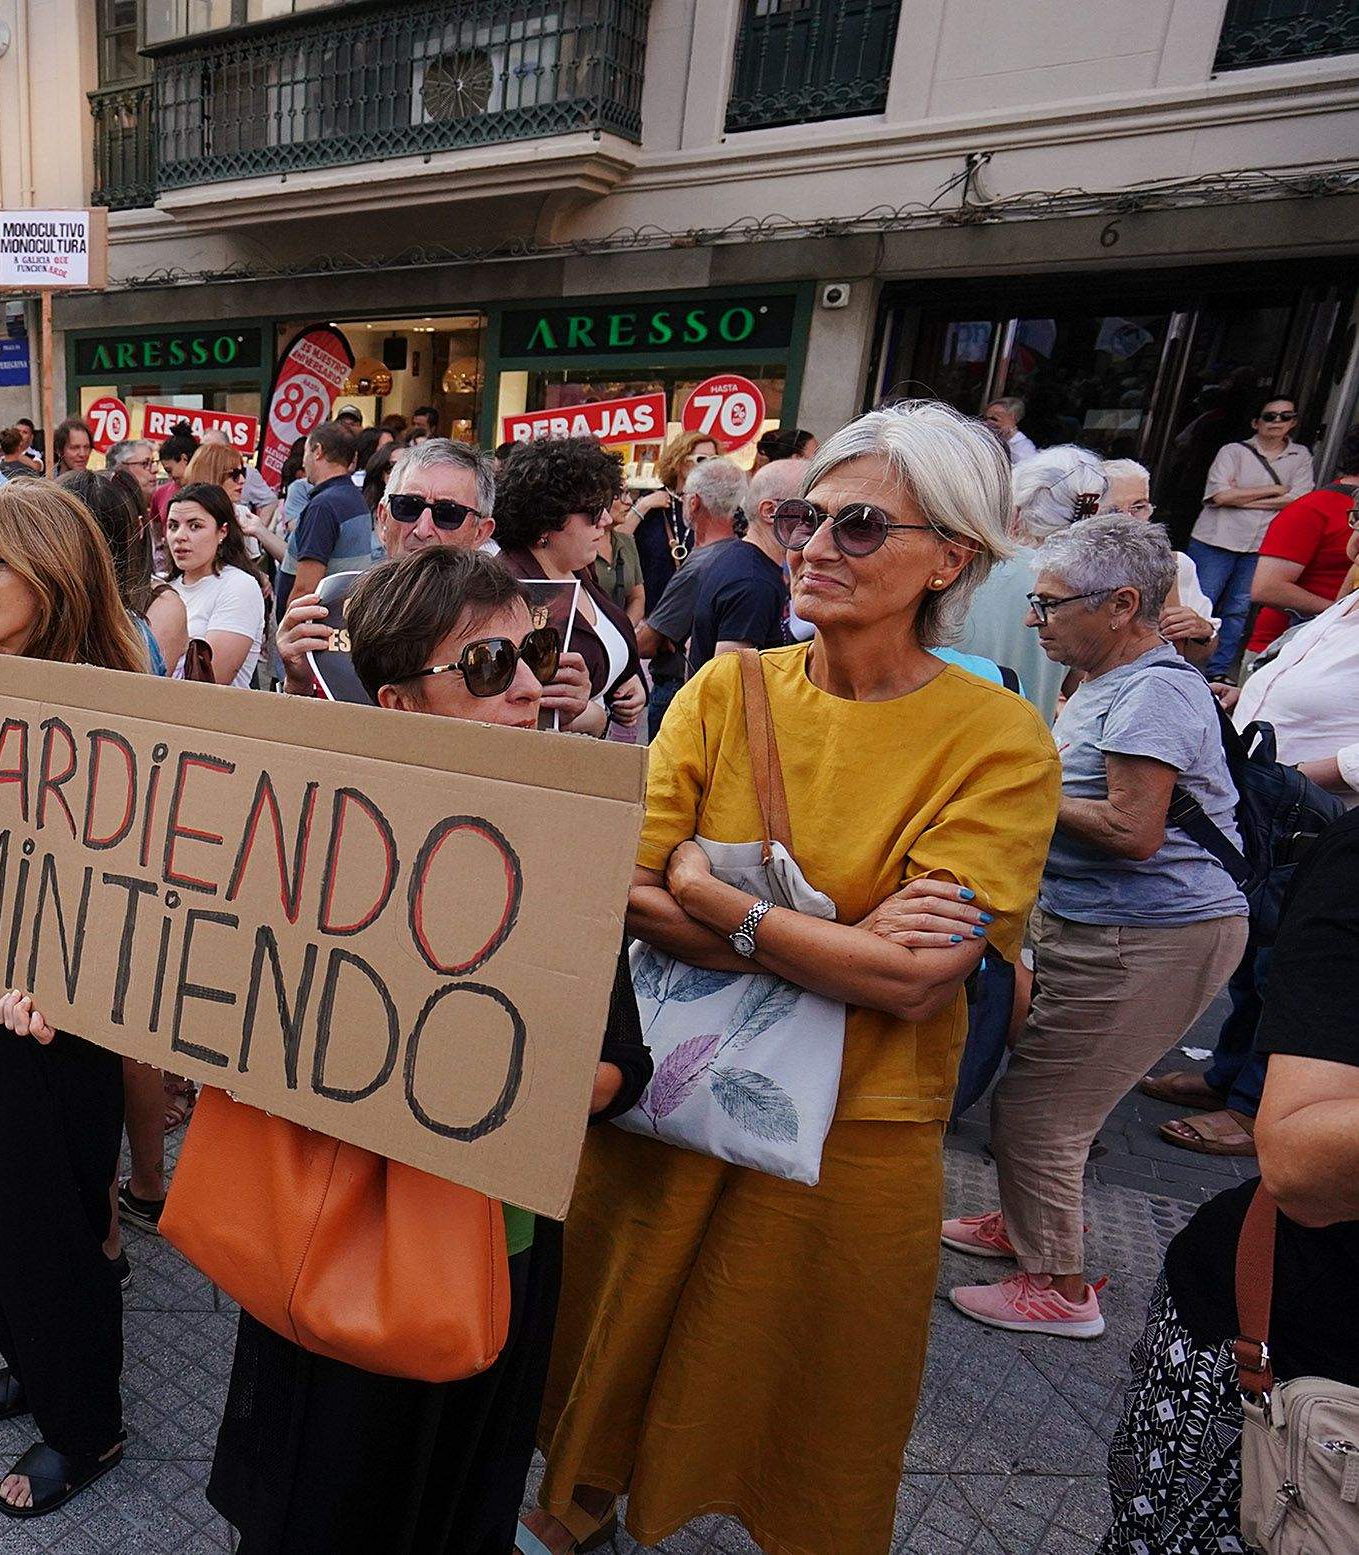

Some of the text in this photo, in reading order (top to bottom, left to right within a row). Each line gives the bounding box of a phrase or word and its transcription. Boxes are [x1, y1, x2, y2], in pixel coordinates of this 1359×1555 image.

[3, 222, 85, 237] MONOCULTIVO
[1101, 219, 1122, 247] 6
[0, 239, 87, 253] MONOCULTURA
[22, 256, 51, 264] GALICIA
[526, 307, 756, 350] ARESSO
[92, 336, 237, 370] ARESSO
[710, 384, 739, 393] HASTA
[274, 383, 325, 435] 80
[694, 392, 757, 437] 70
[90, 409, 127, 442] 70
